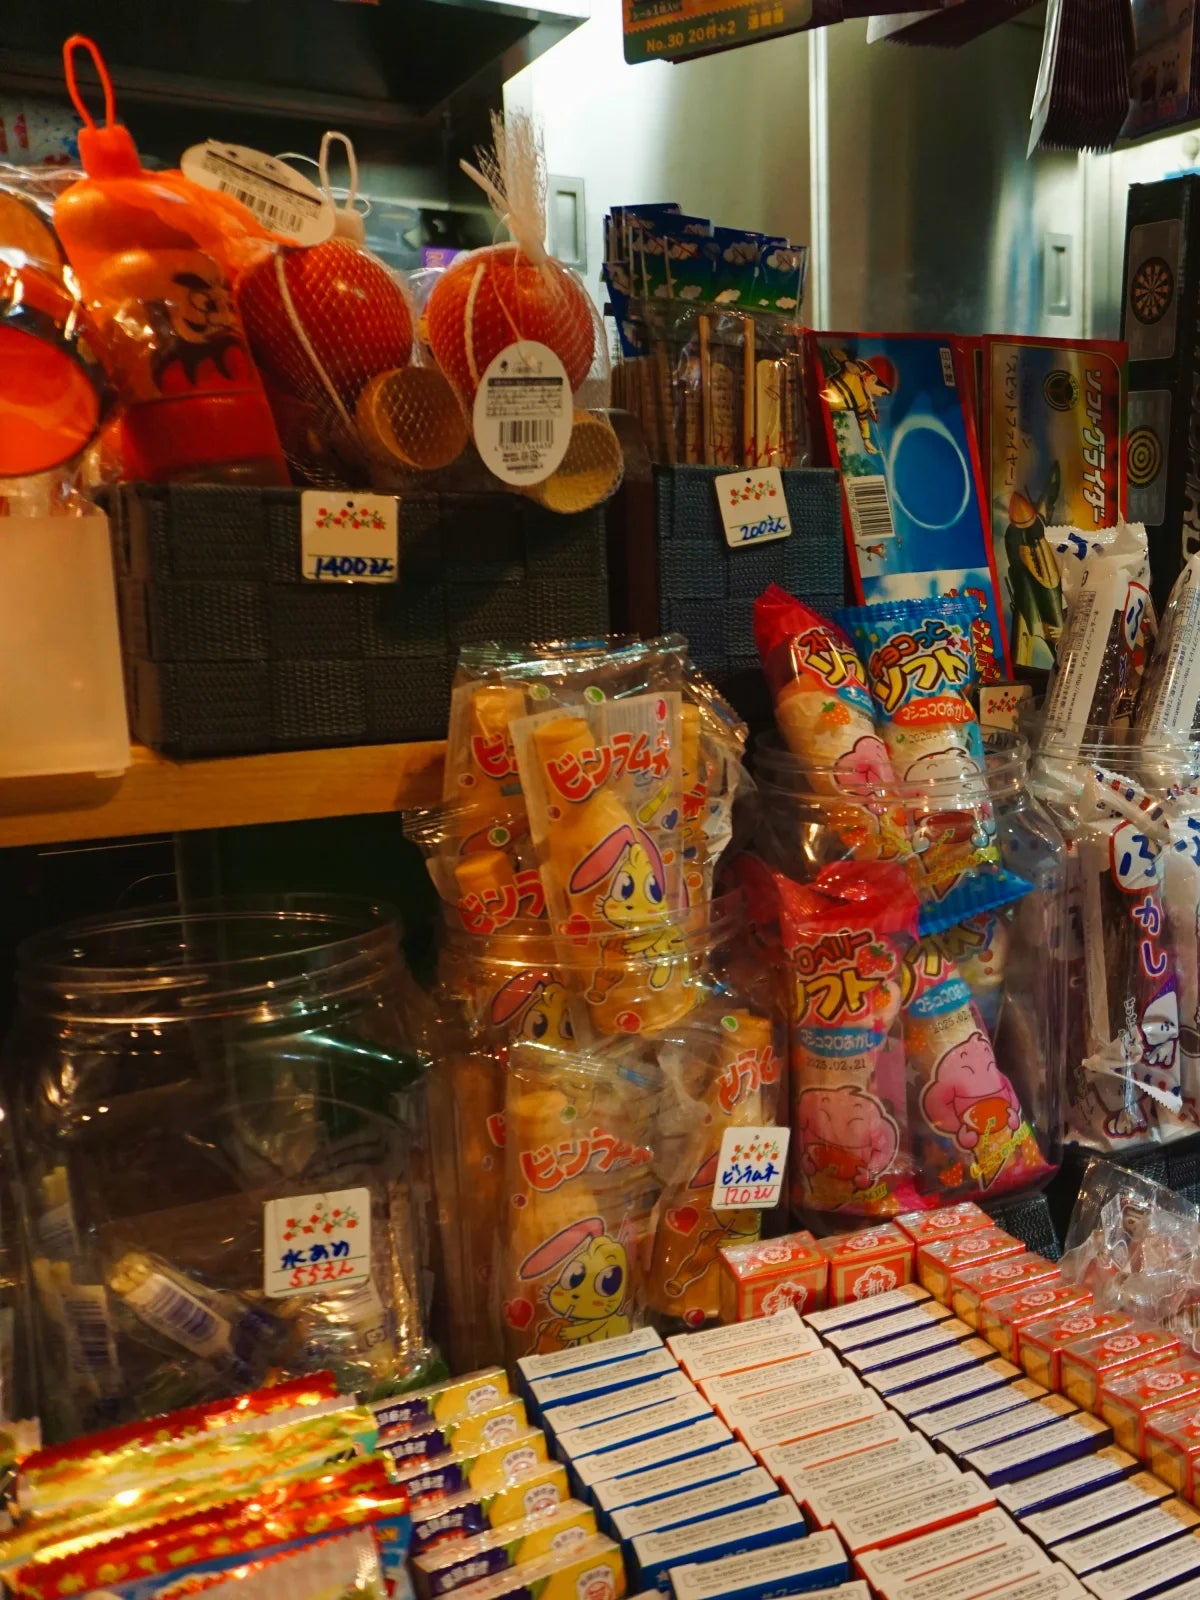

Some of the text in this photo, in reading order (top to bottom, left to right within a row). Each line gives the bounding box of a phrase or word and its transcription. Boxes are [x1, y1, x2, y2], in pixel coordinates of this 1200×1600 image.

[646, 32, 685, 53] No.30
[1082, 368, 1106, 525] ソフトグライダー
[740, 514, 787, 541] 200えん
[868, 619, 952, 680] チョコっと
[872, 645, 970, 714] ソフト
[546, 729, 672, 803] ビンラムネ
[721, 1163, 780, 1187] ビンラムネ
[723, 1186, 776, 1209] 120えん
[281, 1240, 350, 1269] 水あめ
[290, 1261, 355, 1288] 55えん
